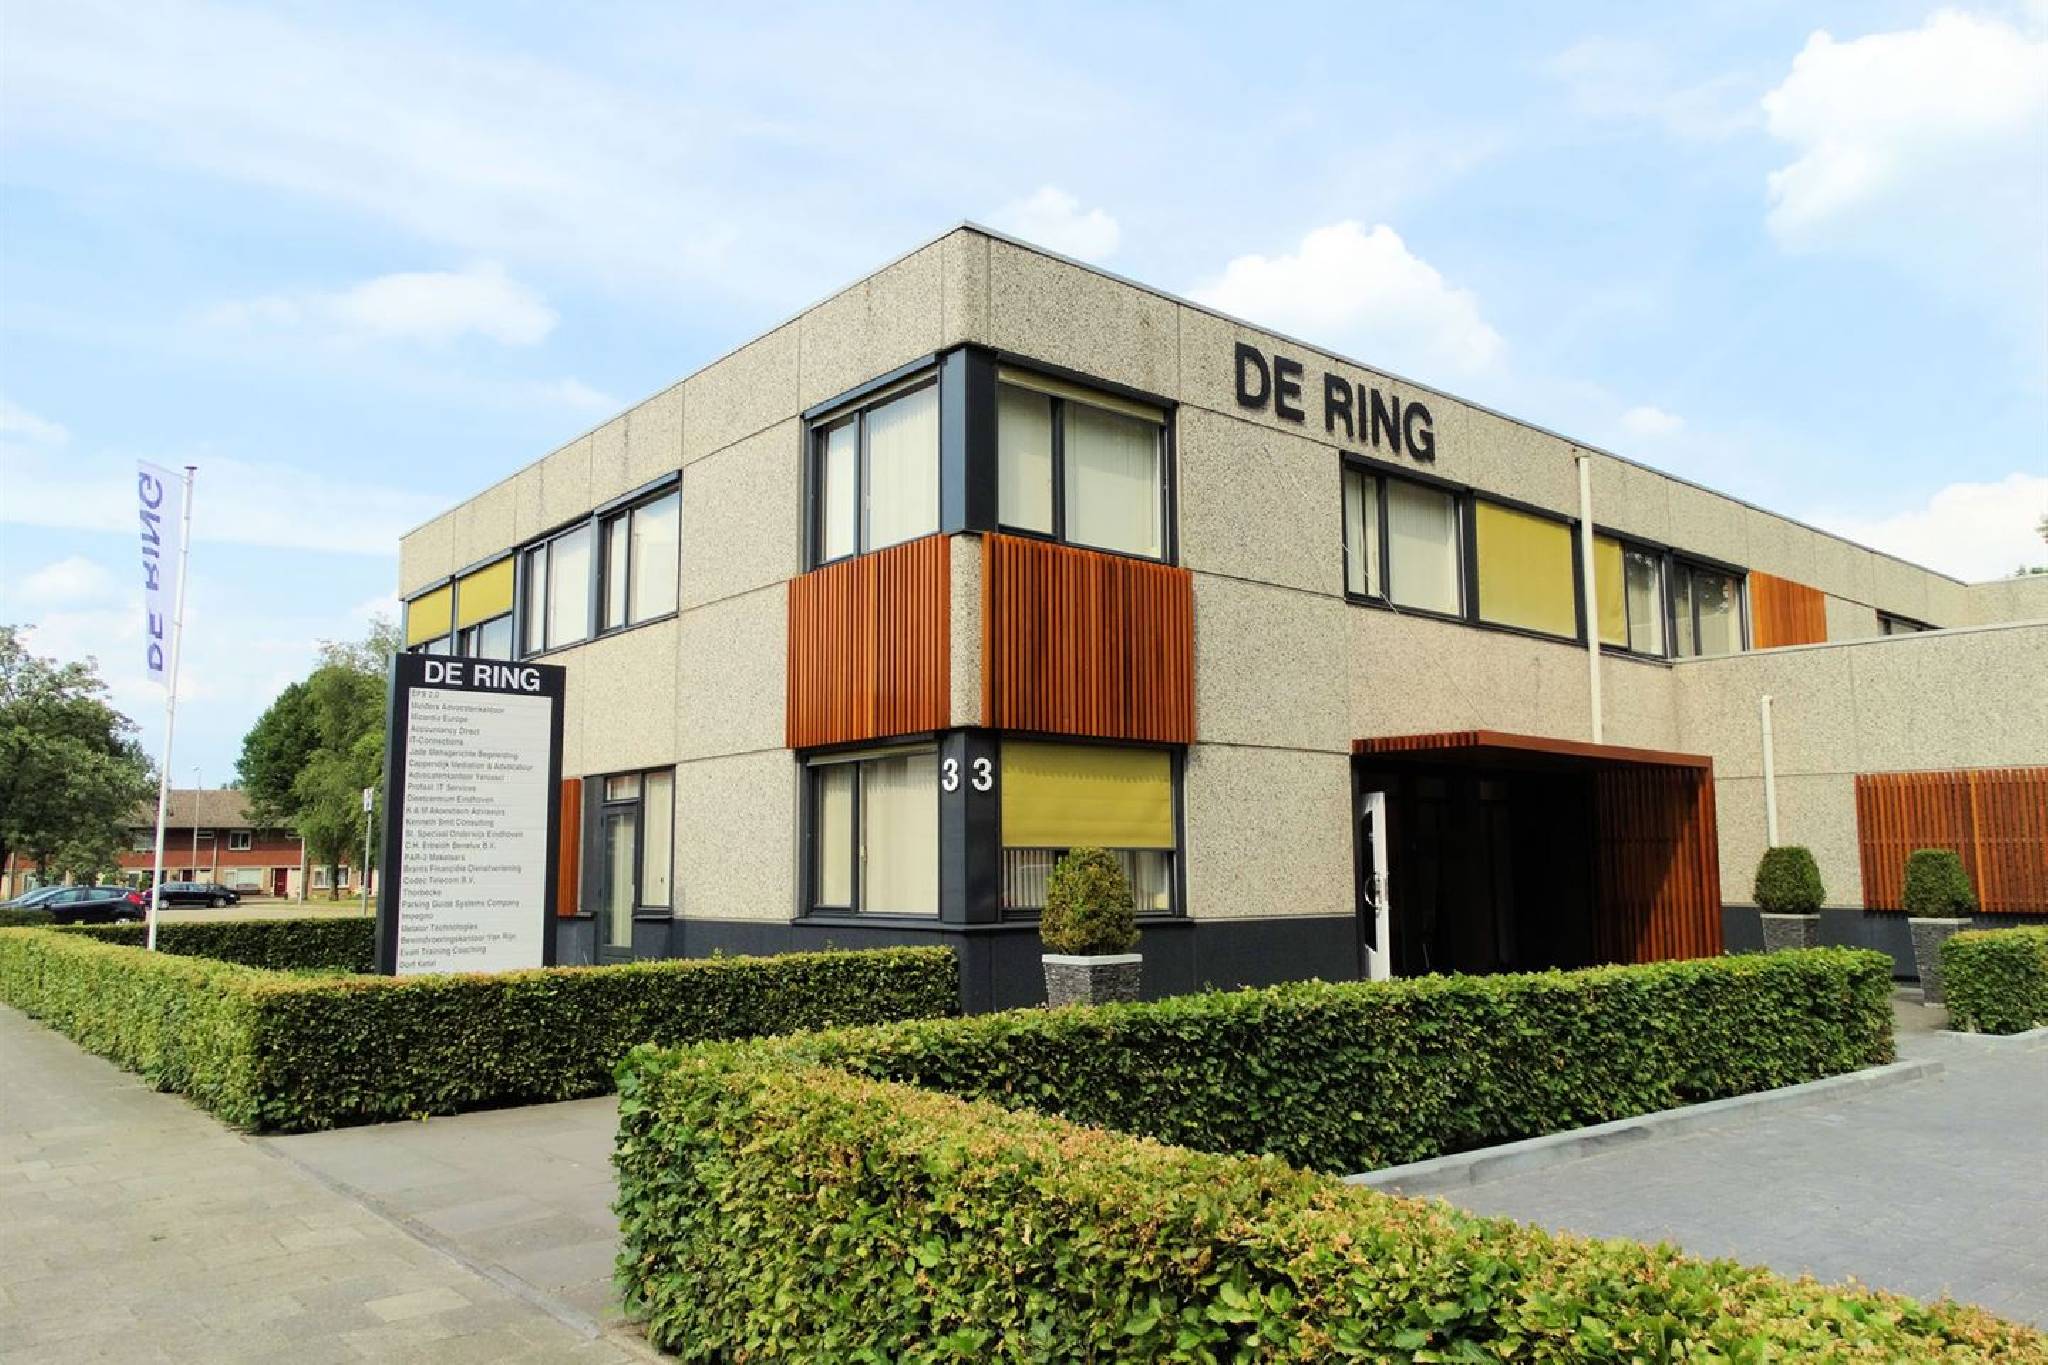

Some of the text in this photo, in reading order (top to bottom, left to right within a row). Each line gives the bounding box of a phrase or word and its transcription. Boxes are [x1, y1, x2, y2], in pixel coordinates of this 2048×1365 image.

[1235, 341, 1436, 463] DE RING
[425, 660, 540, 691] DE RING
[402, 901, 429, 909] Parking
